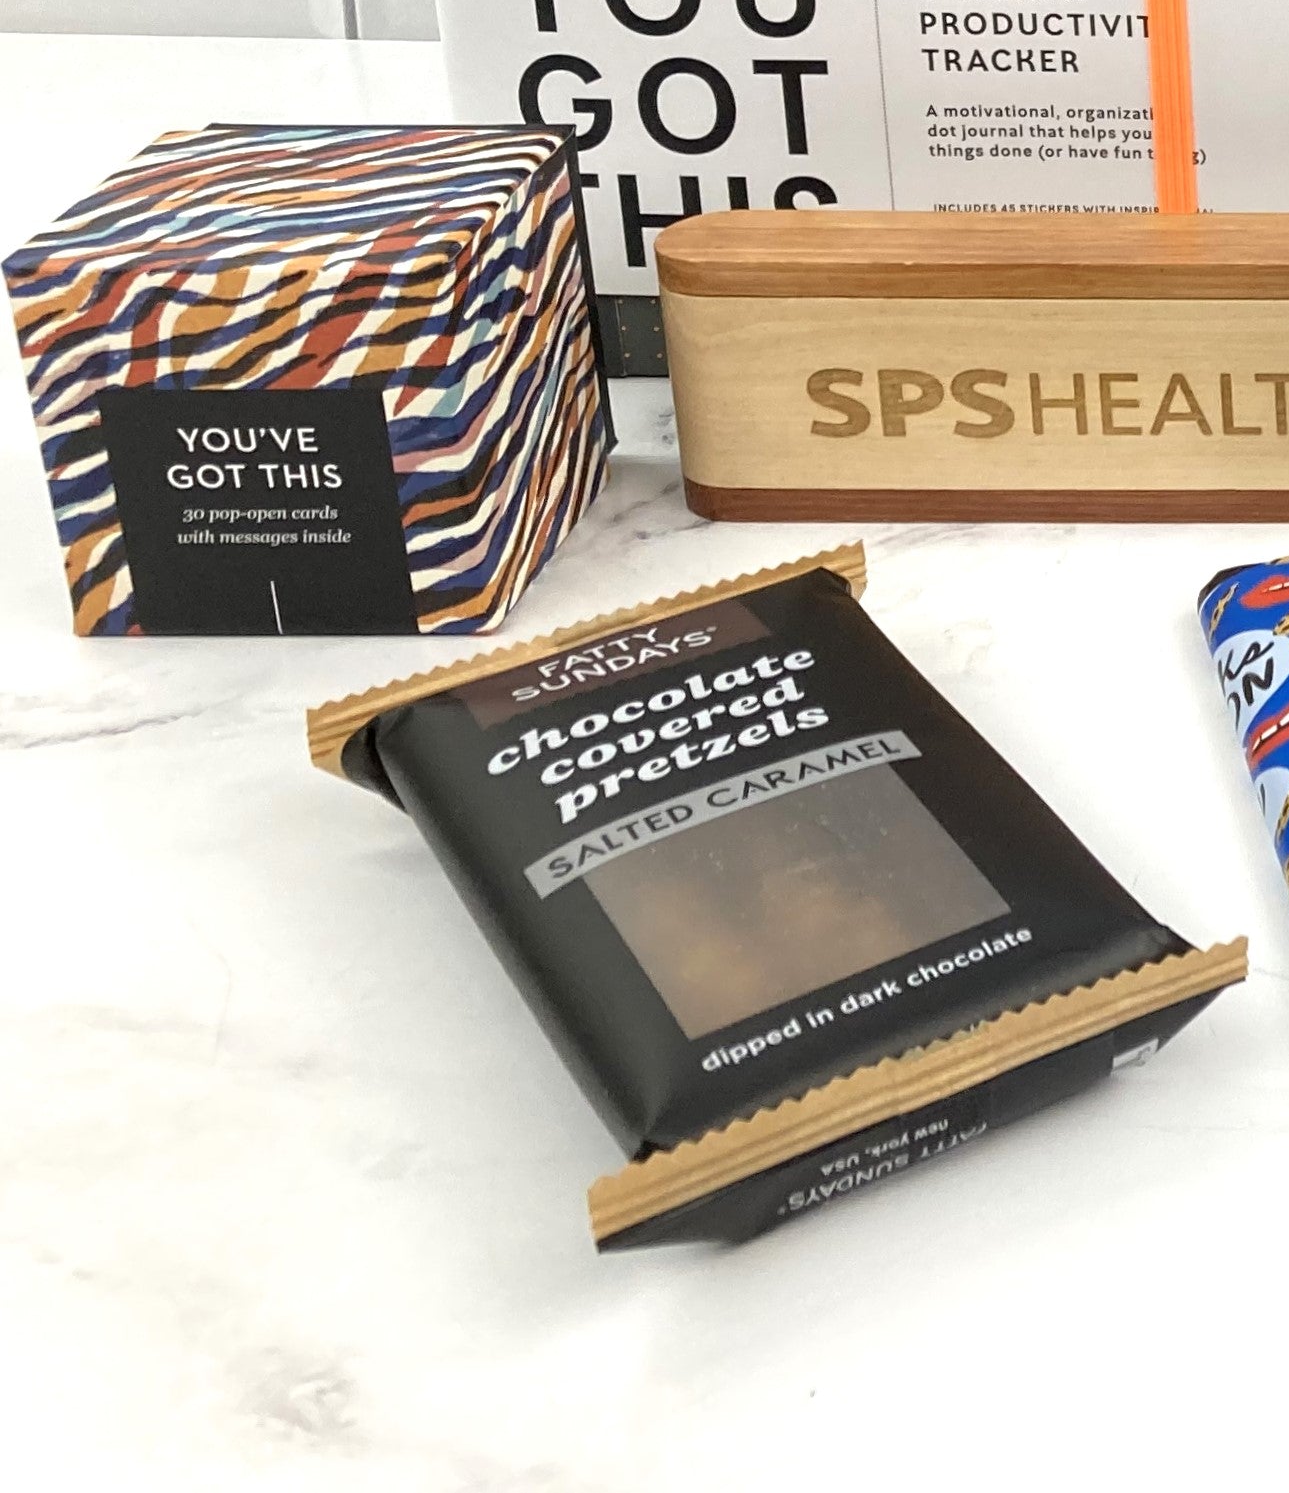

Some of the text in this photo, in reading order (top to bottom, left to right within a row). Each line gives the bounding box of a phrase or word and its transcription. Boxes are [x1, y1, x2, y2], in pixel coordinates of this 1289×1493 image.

[919, 11, 1150, 39] PRODUCTIVIT
[921, 47, 1079, 75] TRACKER
[518, 55, 828, 156] GOT
[926, 104, 1154, 123] A motivational, organizati
[927, 123, 1153, 143] dot journal that helps you
[928, 143, 984, 161] things
[989, 143, 1033, 158] done
[1037, 144, 1063, 162] (or
[1068, 145, 1109, 159] have
[1113, 145, 1142, 160] fun
[176, 427, 319, 453] YOU'VE
[166, 463, 344, 490] GOT THIS
[181, 504, 339, 525] 30 pop-open cards
[176, 528, 353, 548] with messages inside
[537, 627, 660, 678] FATTY
[486, 648, 816, 776] chocolate
[540, 677, 805, 788] covered
[554, 706, 830, 826] pretzels
[547, 739, 903, 879] SALTED CARAMEL
[700, 926, 1033, 1074] dipped in dark chocolate
